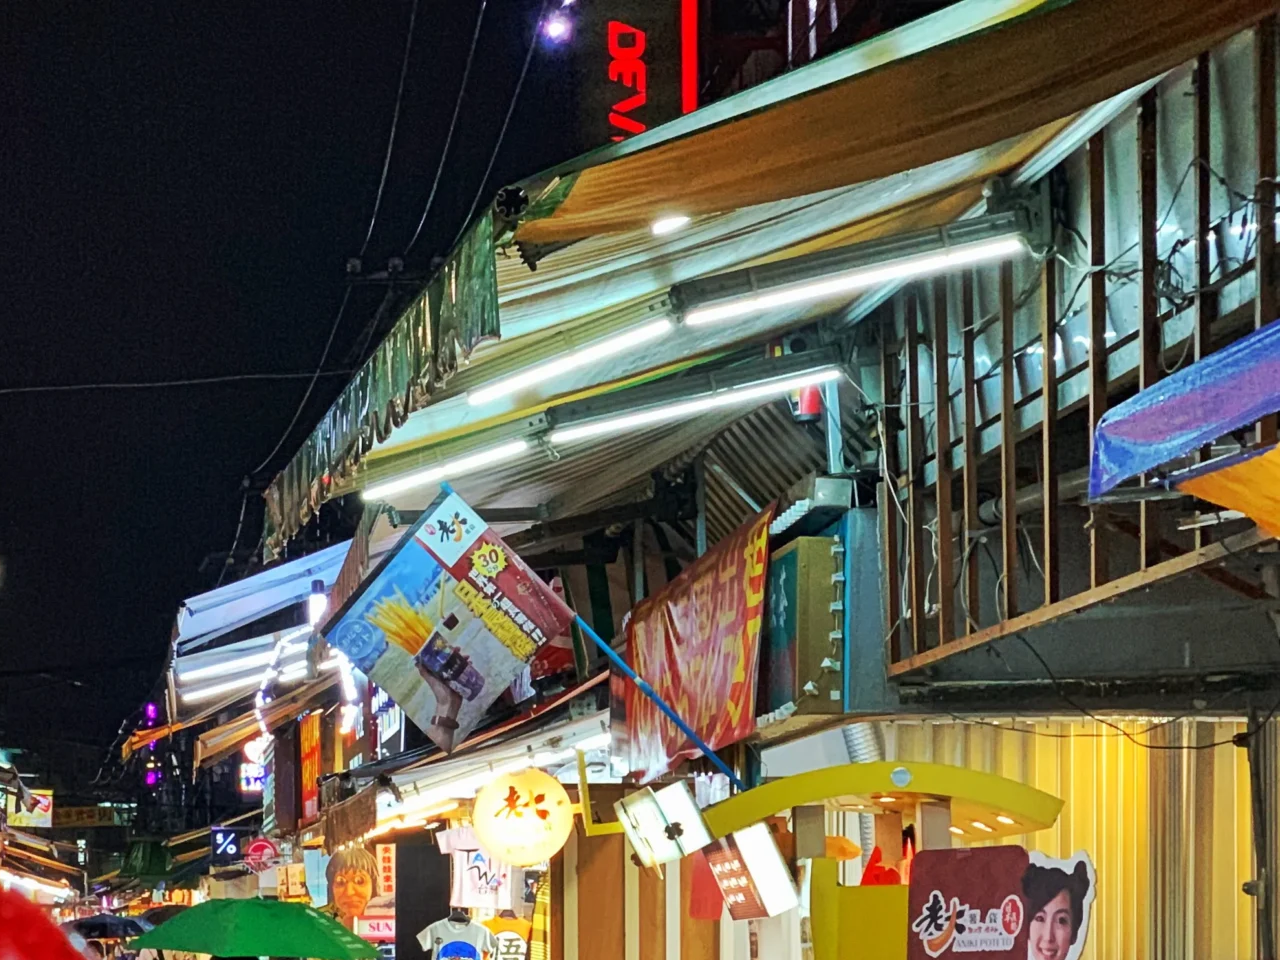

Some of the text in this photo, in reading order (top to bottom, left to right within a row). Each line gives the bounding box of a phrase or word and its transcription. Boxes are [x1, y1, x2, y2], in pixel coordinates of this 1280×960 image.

[608, 21, 646, 142] DEV
[477, 551, 500, 568] 30
[368, 921, 393, 933] SUN
